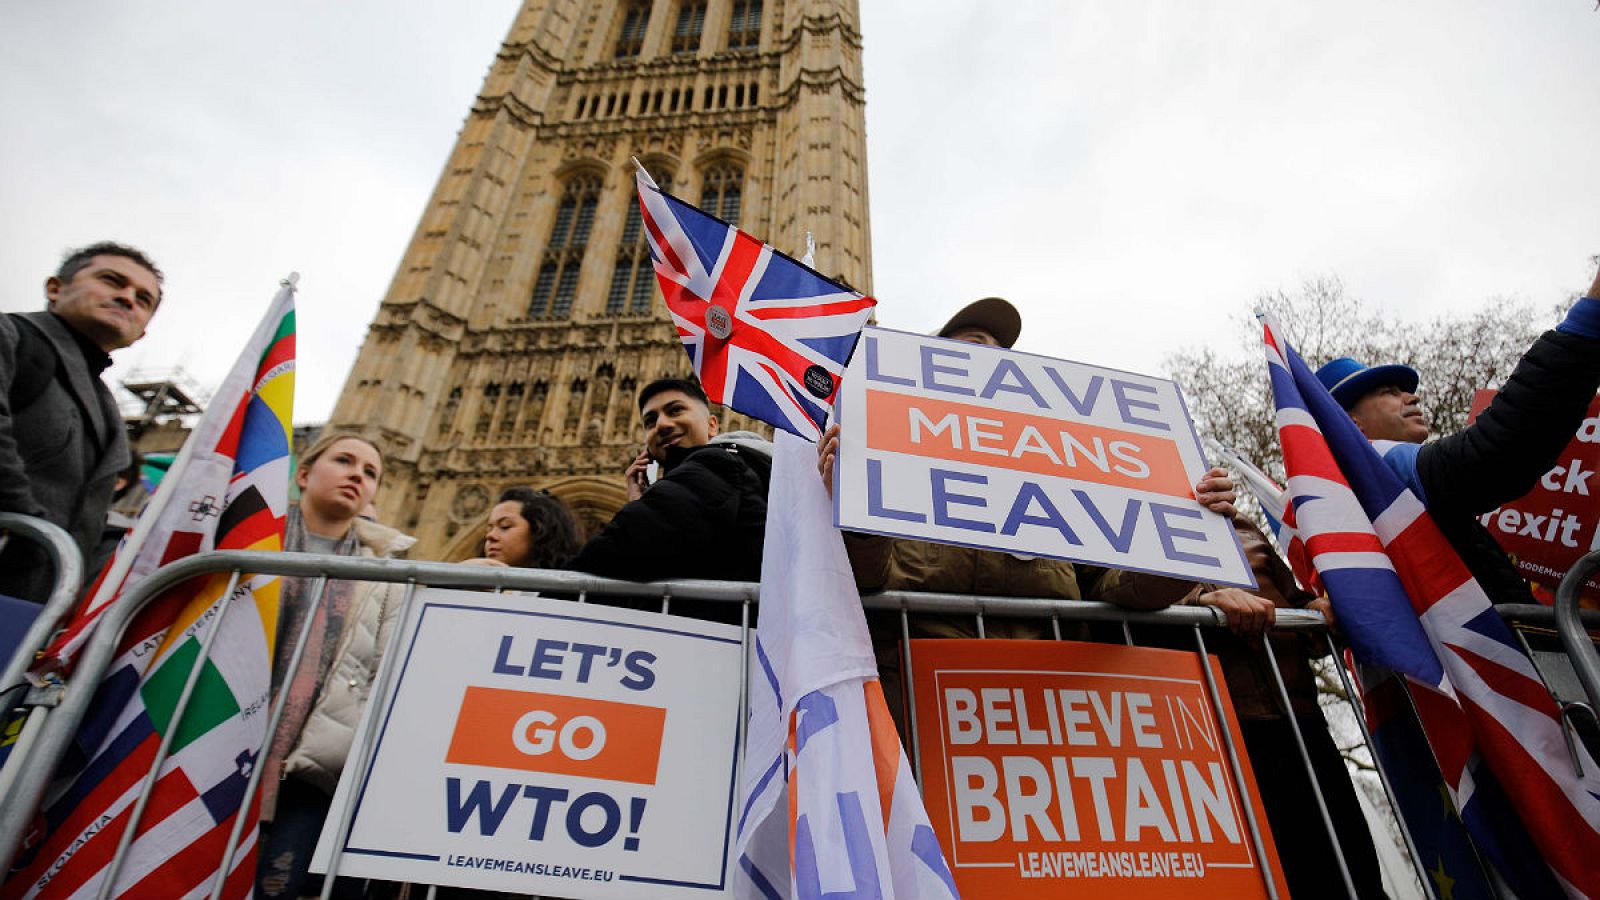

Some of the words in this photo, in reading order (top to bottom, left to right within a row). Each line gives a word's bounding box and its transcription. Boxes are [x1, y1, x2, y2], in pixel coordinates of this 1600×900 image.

[866, 336, 1171, 431] LEAVE
[908, 407, 1151, 479] MEANS
[867, 458, 1222, 568] LEAVE
[1476, 506, 1582, 548] rexit
[492, 635, 657, 691] LET'S
[511, 709, 607, 761] GO
[944, 687, 1163, 748] BELIEVE
[1165, 695, 1217, 753] IN
[445, 776, 648, 852] WTO!
[951, 755, 1243, 845] BRITAIN
[37, 813, 113, 890] SLOVAKIA
[446, 854, 613, 882] LEAVEMEANSLEAVE.EU
[1018, 852, 1205, 878] LEAVEMEANSLEAVE.EU
